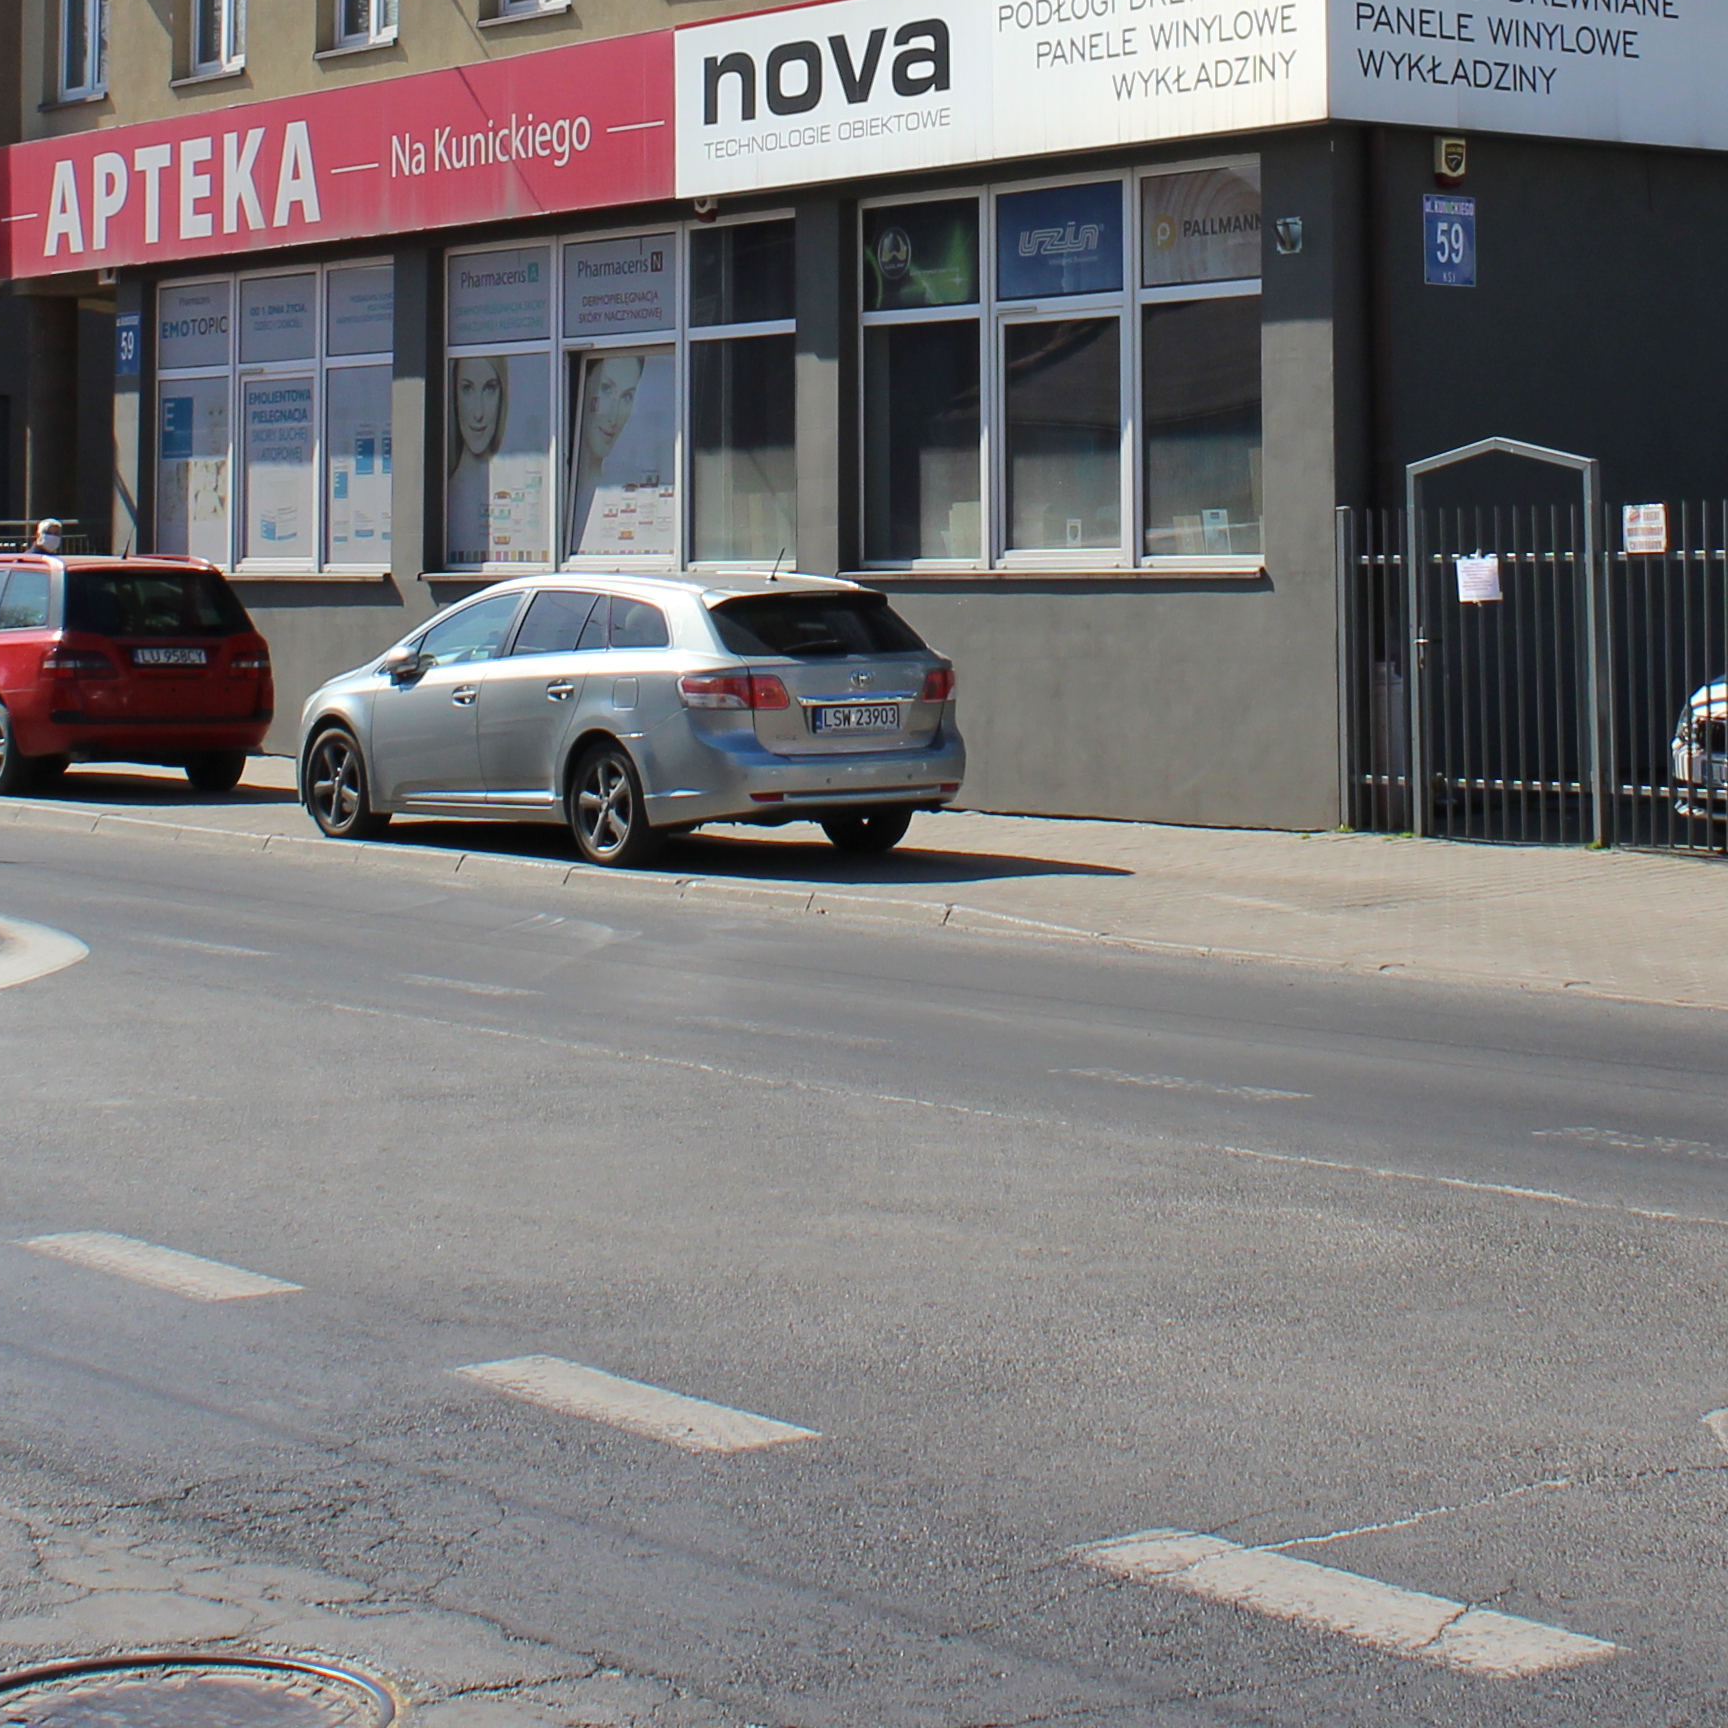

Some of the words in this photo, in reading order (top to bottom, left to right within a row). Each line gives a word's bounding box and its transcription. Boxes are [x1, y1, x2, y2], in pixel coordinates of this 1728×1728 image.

[1036, 27, 1137, 69] PANELE
[1150, 3, 1297, 51] WINYLOWE
[1356, 2, 1475, 42] PANELE
[1488, 16, 1640, 59] WINYLOWE
[704, 18, 950, 126] nova
[1112, 49, 1297, 101] WYKŁADZINY
[1357, 48, 1557, 94] WYKŁADZINY
[390, 134, 426, 177] Na
[432, 112, 592, 172] Kunickiego
[704, 124, 831, 160] TECHNOLOGIE
[838, 107, 950, 141] OBIEKTOWE
[43, 119, 322, 257] APTEKA
[1436, 221, 1464, 264] 59
[461, 270, 526, 288] Pharmaceris
[578, 258, 648, 278] Pharmaceris
[651, 252, 662, 272] N
[121, 330, 135, 361] 59
[162, 316, 228, 339] EMOTOPIC
[248, 389, 311, 405] EMOLIENTOWA
[142, 650, 161, 663] LU
[164, 650, 204, 663] 958CY
[824, 709, 852, 727] LSW
[856, 707, 897, 726] 23903
